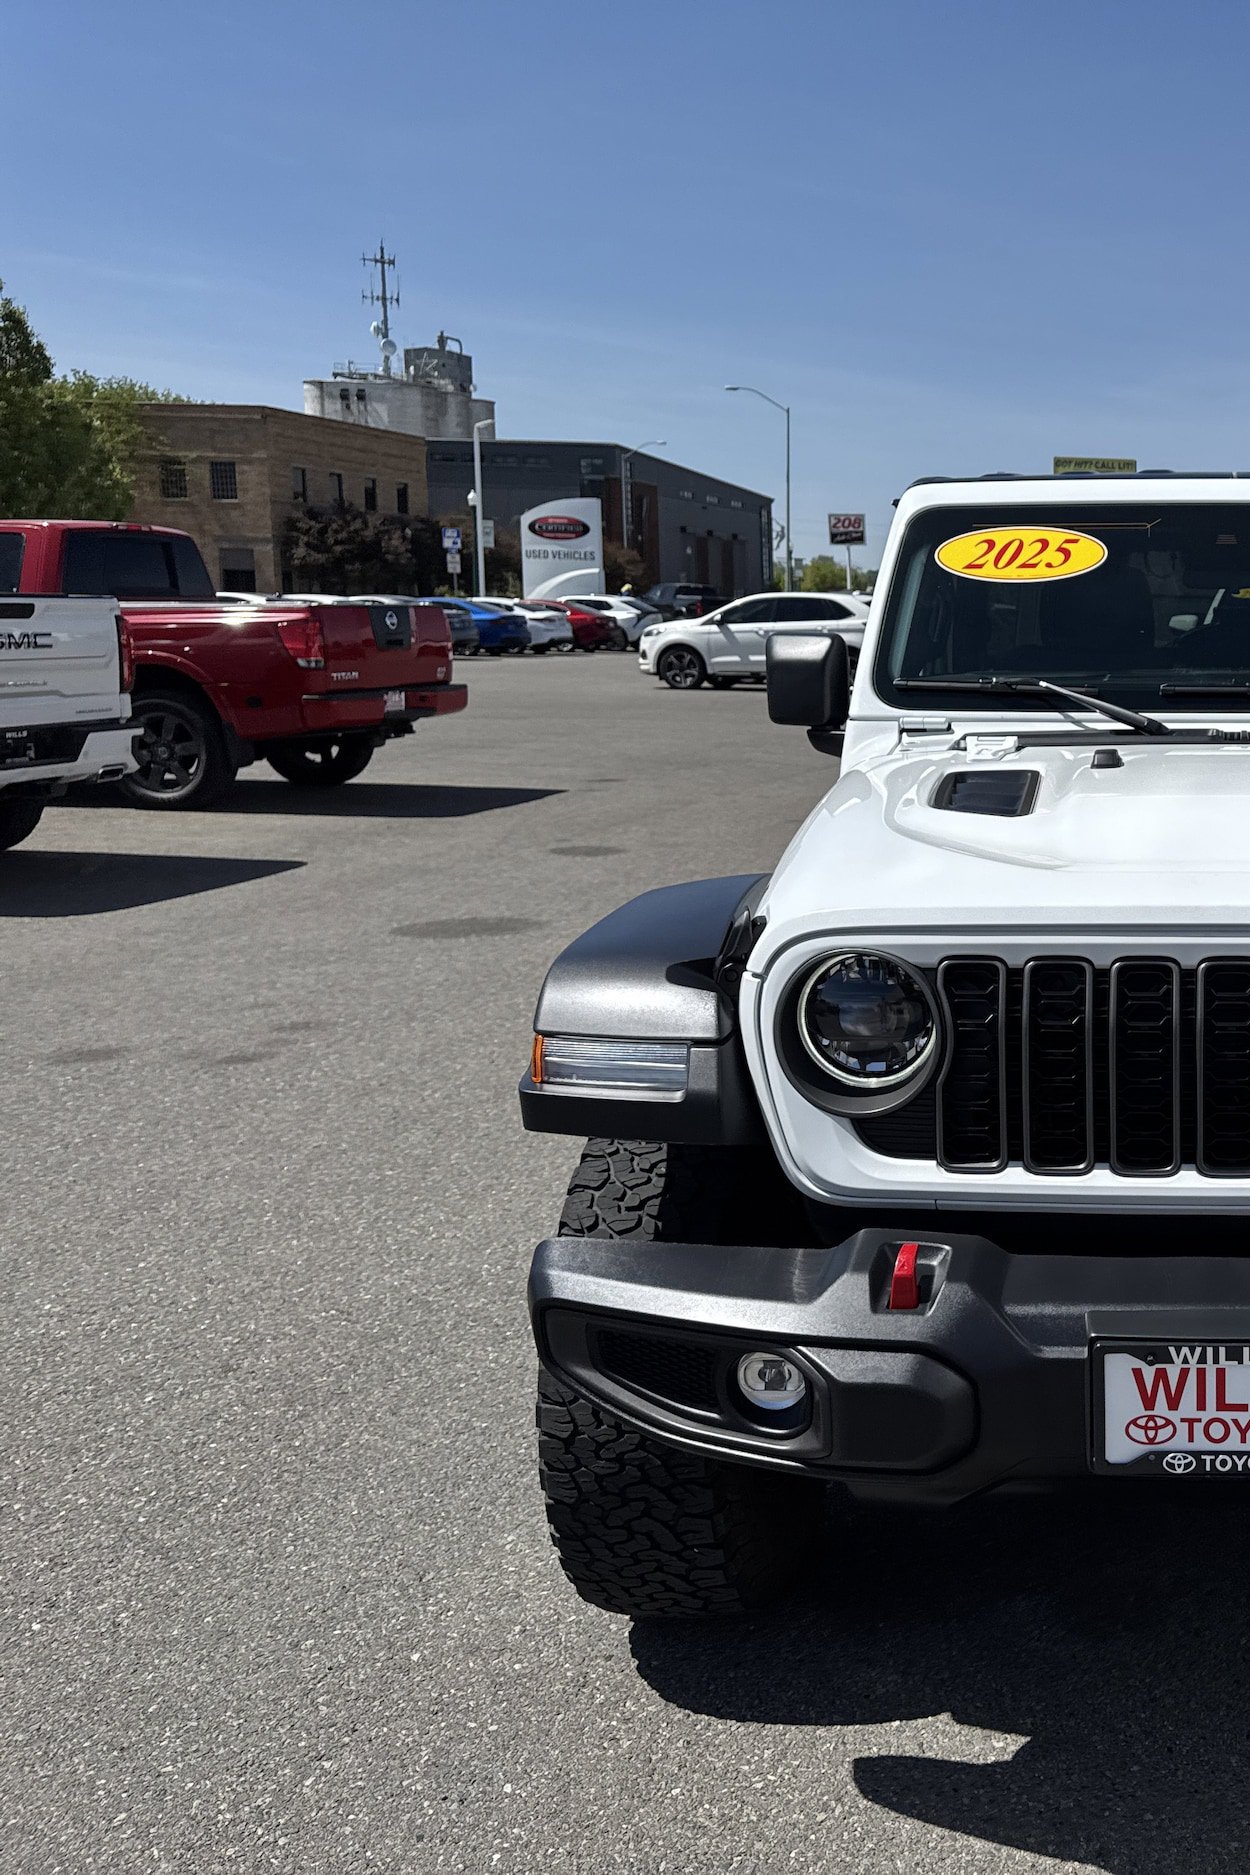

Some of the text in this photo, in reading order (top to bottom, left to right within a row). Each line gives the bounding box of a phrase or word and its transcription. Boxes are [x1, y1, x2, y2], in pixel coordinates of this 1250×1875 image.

[1095, 461, 1116, 470] CALL
[832, 516, 862, 529] 208
[525, 549, 596, 561] USED VEHICLES
[961, 538, 1081, 570] 2025
[331, 671, 359, 681] TITAN
